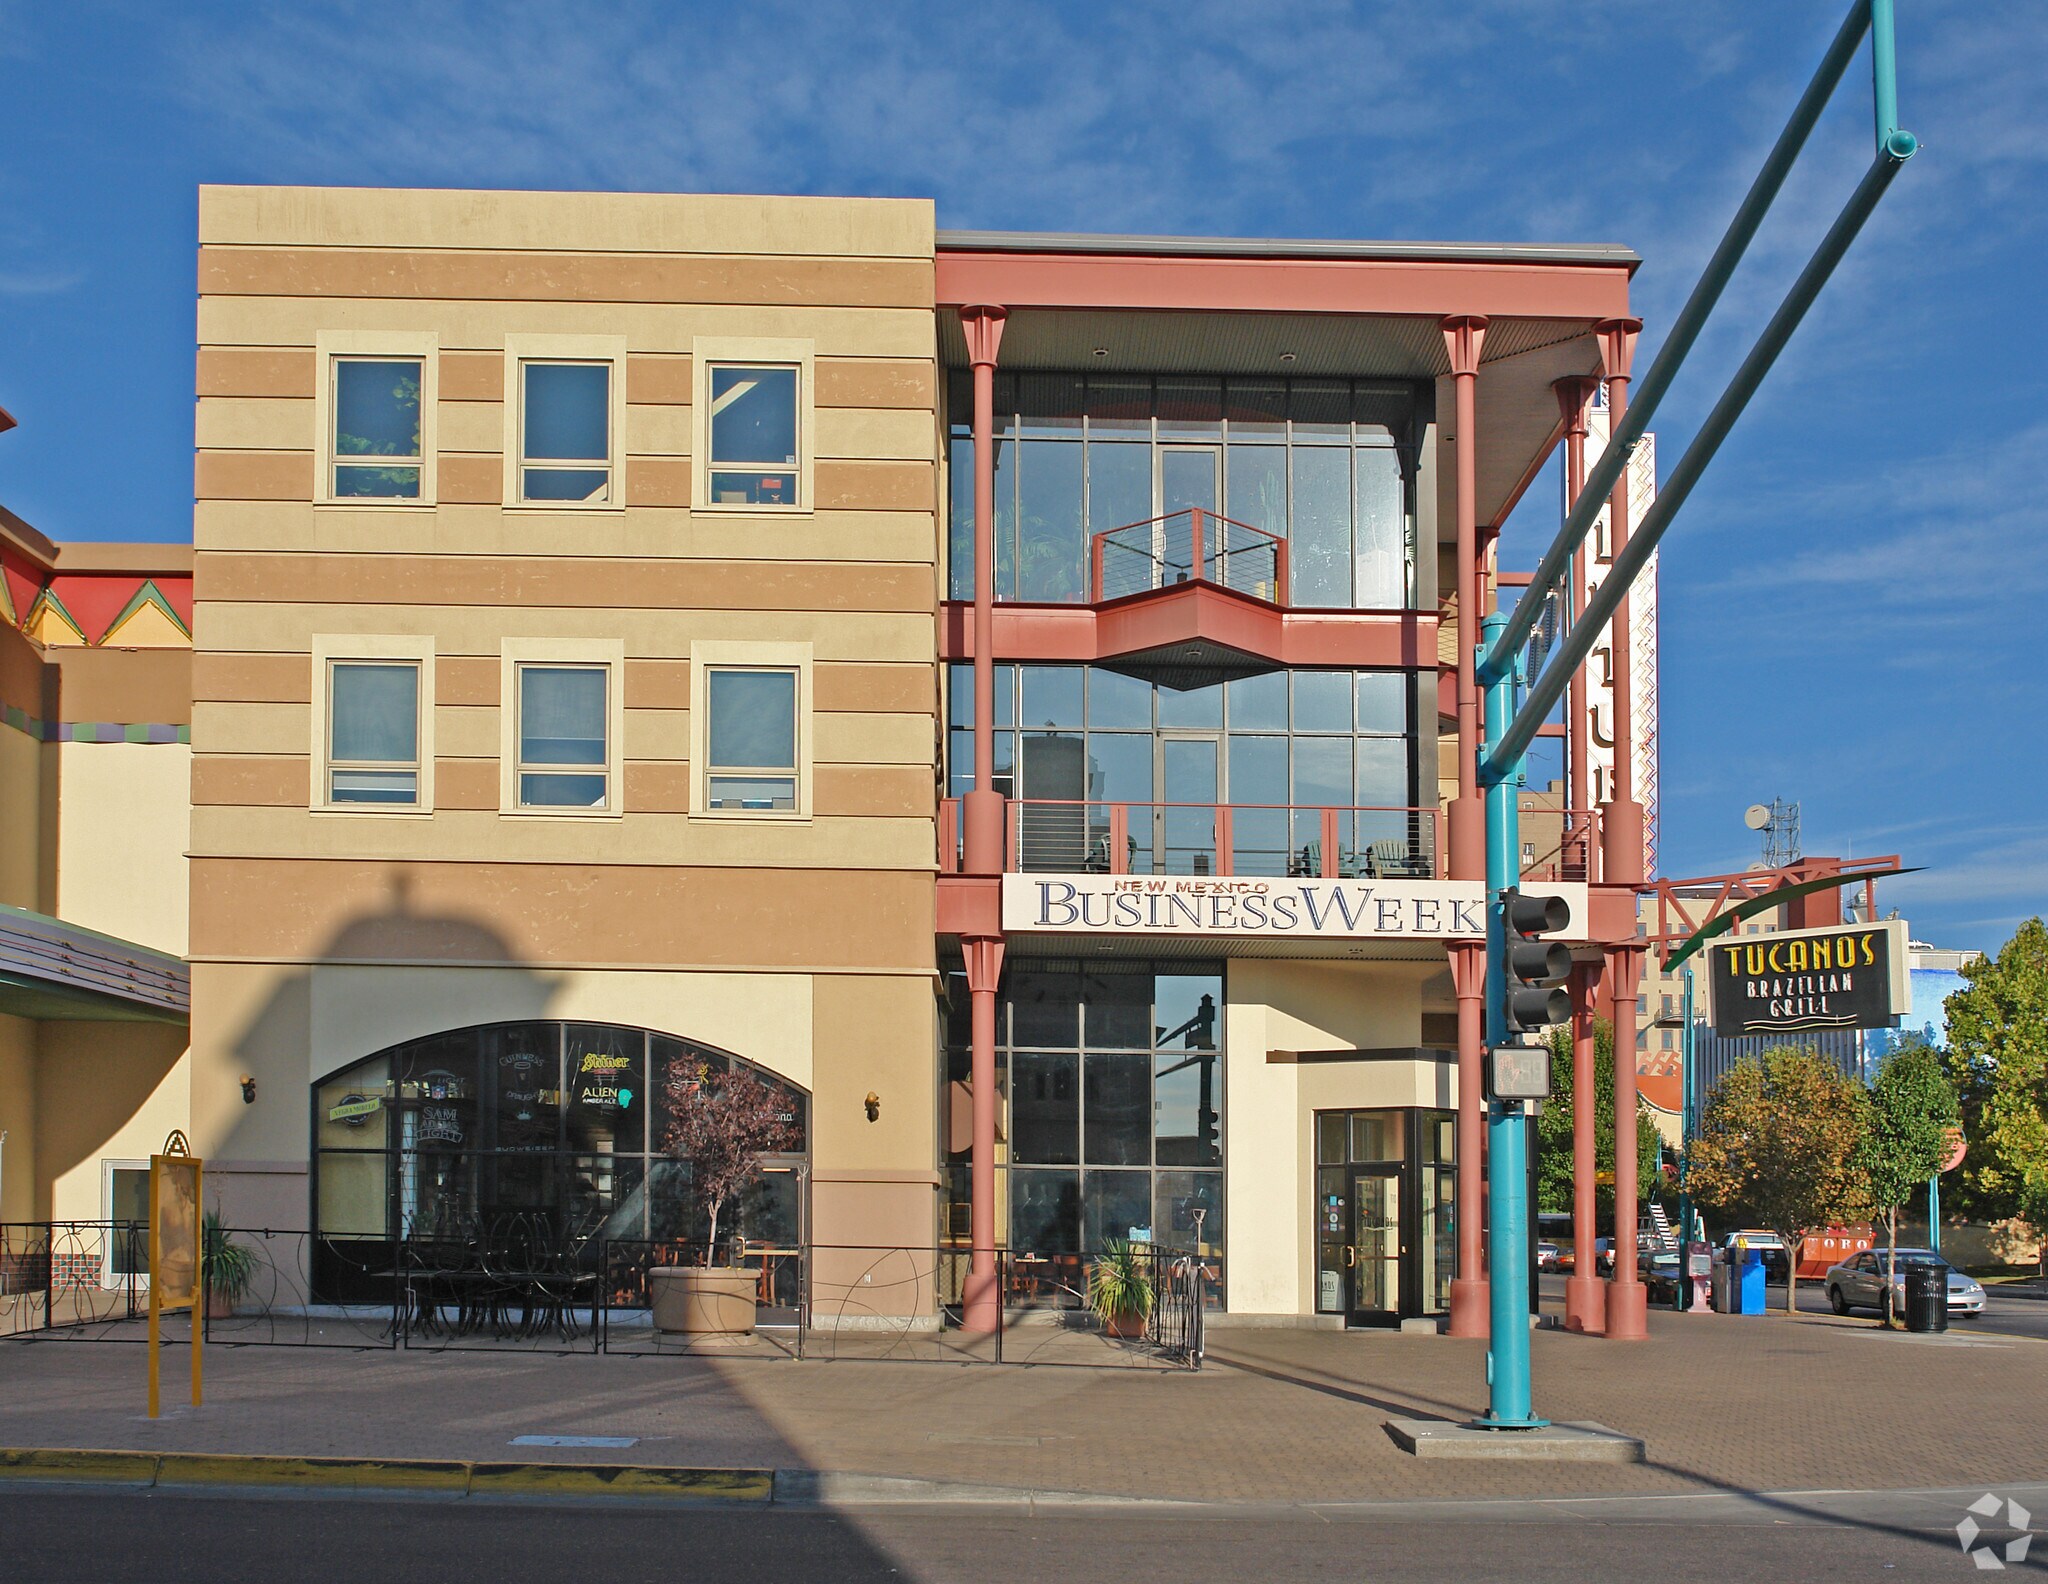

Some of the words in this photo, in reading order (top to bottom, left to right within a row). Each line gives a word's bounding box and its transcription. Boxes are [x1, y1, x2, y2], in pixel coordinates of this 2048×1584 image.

[1115, 880, 1167, 893] NEW
[1176, 881, 1270, 894] MEXICO
[1723, 934, 1875, 976] TUCANOS
[1746, 973, 1853, 998] BRAZILIAN
[1769, 995, 1829, 1018] GRILL
[581, 1052, 630, 1072] Shiner
[581, 1087, 618, 1098] ALIEN
[422, 1106, 458, 1121] SAM
[419, 1130, 459, 1143] LIGHT
[495, 1145, 556, 1153] BUDWEISER
